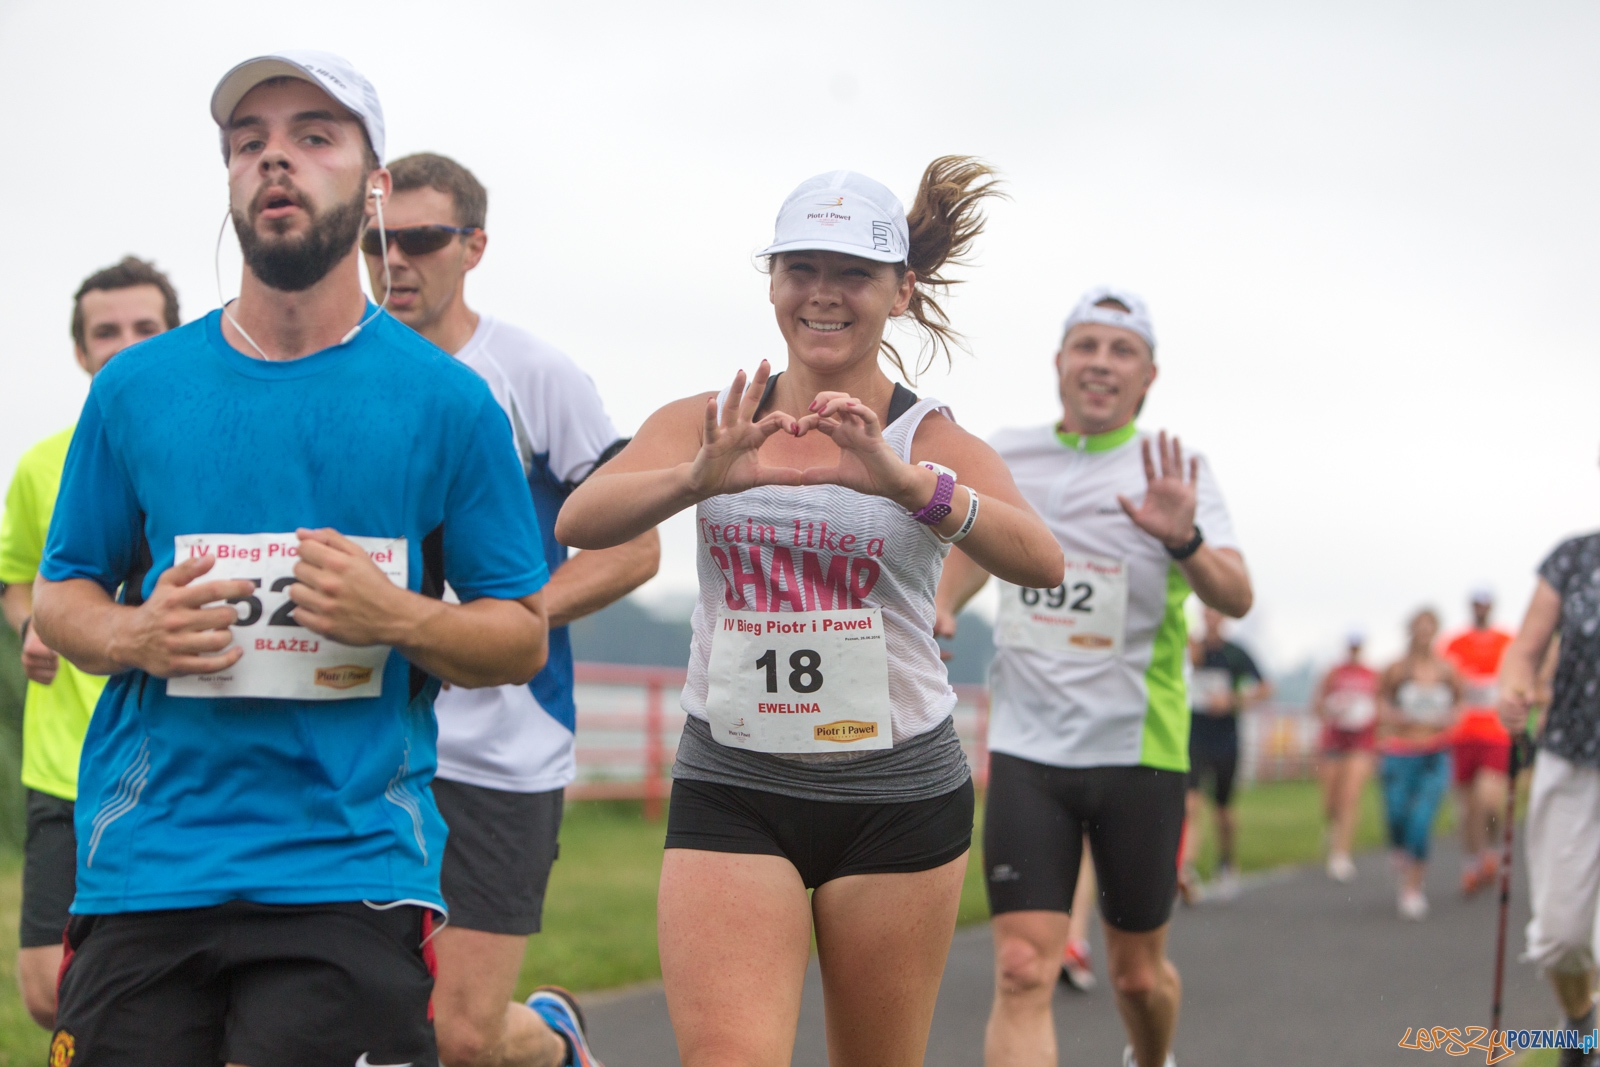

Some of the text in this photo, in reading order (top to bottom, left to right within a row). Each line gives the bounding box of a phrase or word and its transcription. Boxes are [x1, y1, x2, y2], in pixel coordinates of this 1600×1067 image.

[700, 517, 885, 557] Train like a
[190, 543, 299, 562] IV Bieg Pio
[1020, 582, 1094, 613] 692
[723, 616, 872, 636] IV Bieg Piotr i Paweł
[254, 636, 319, 653] BŁAŻEJ
[755, 649, 824, 694] 18
[758, 703, 821, 714] EWELINA
[816, 725, 875, 736] Piotr i Paweł
